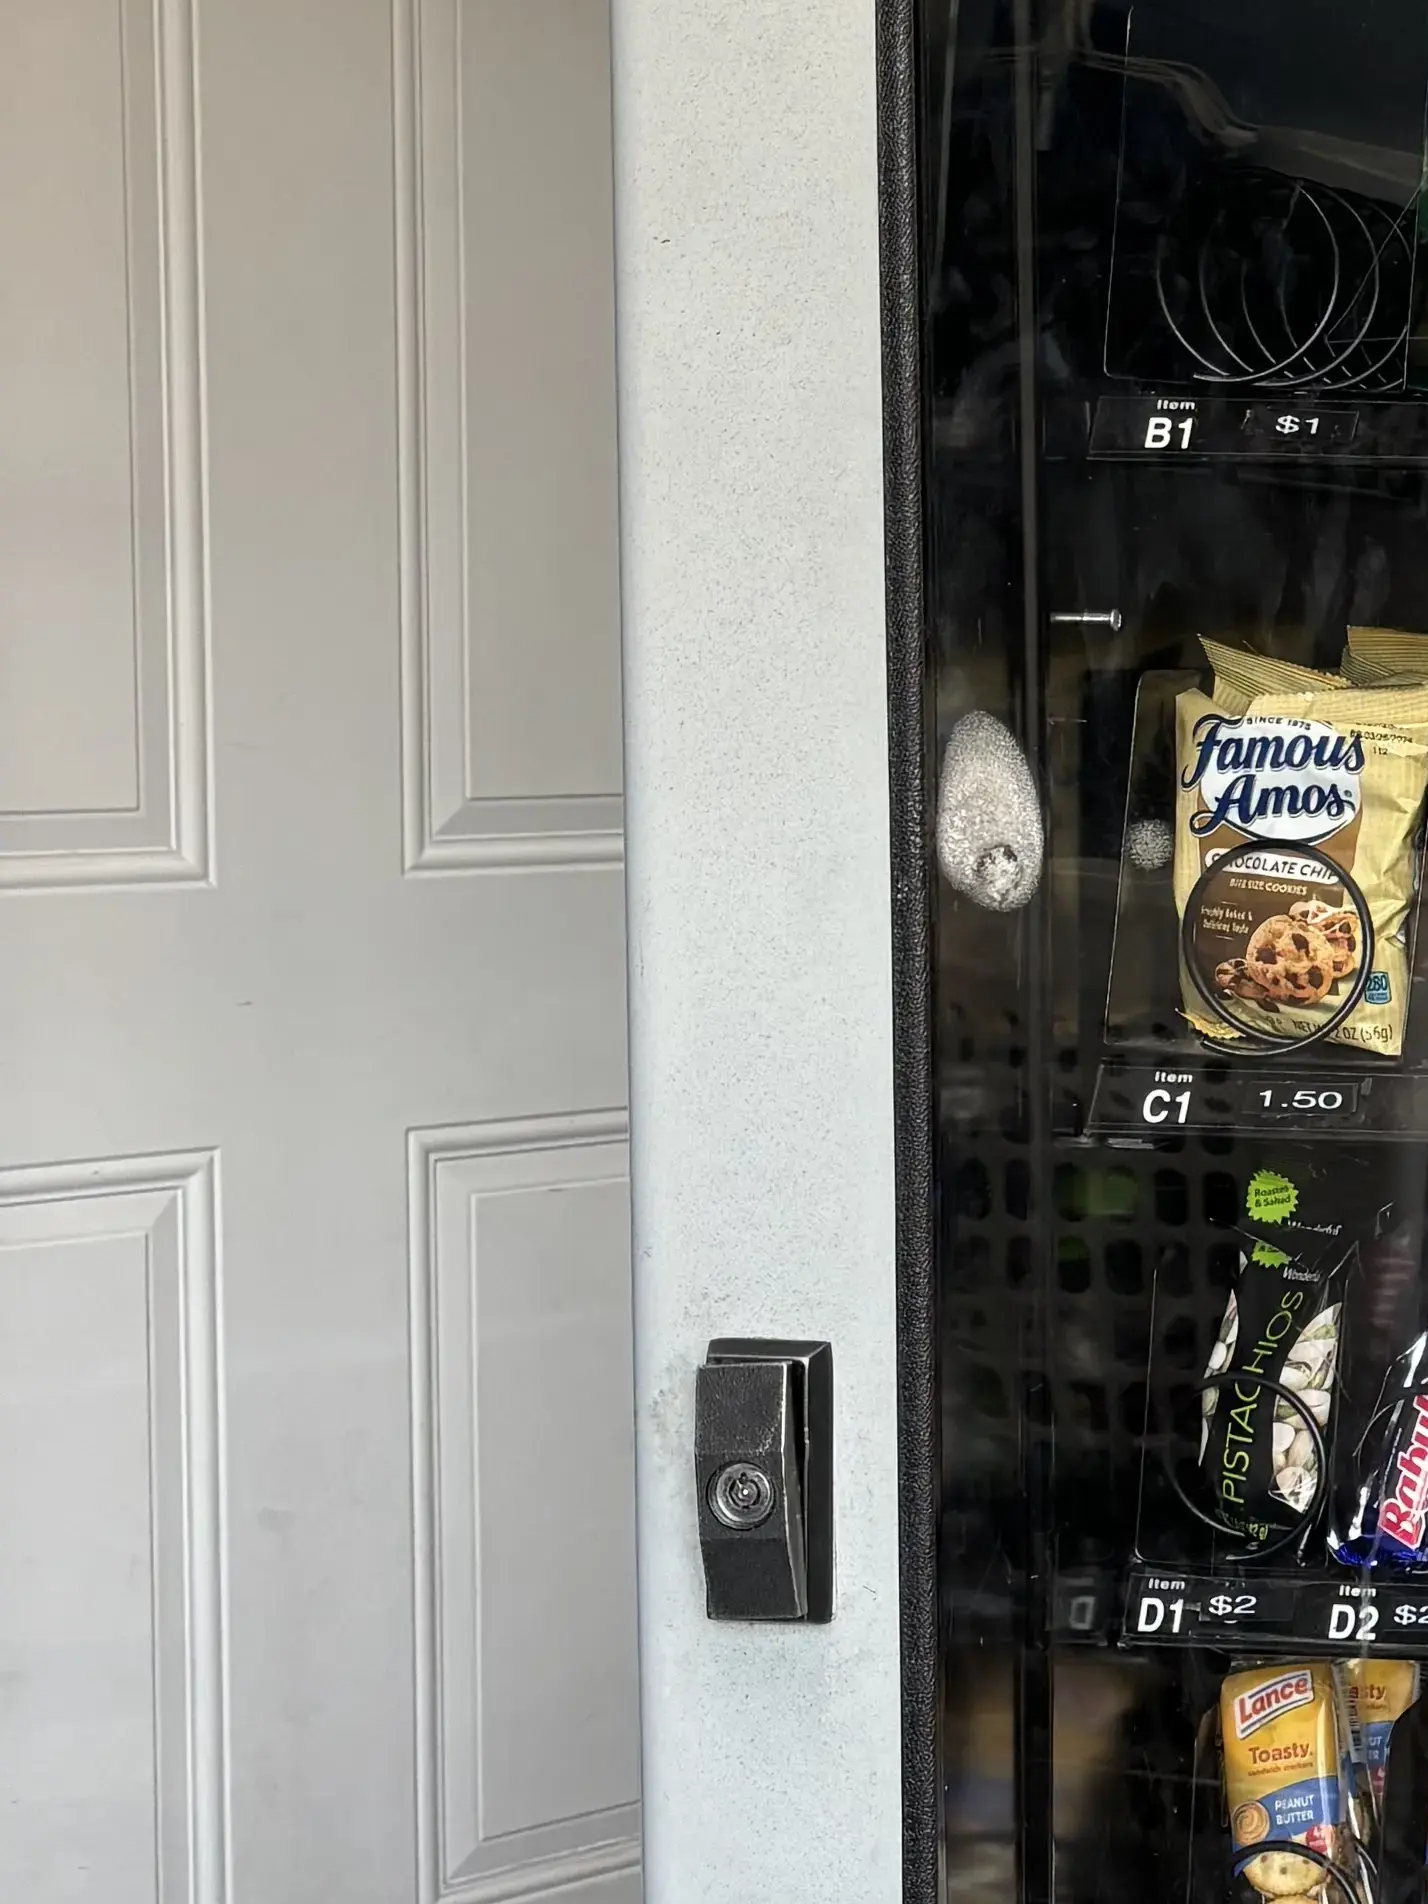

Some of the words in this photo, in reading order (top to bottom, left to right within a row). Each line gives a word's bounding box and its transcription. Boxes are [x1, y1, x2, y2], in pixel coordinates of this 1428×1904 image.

[1144, 416, 1196, 449] B1
[1181, 713, 1366, 790] Famous
[1190, 773, 1355, 836] Amos
[1141, 1090, 1193, 1125] C1
[1258, 1089, 1344, 1111] 1.50
[1222, 1291, 1304, 1503] PISTACHIOS
[1137, 1597, 1188, 1634] D1
[1329, 1605, 1380, 1642] D2
[1238, 1673, 1311, 1725] Lance
[1275, 1794, 1314, 1812] PEANUT
[1276, 1809, 1314, 1826] BUTTER
